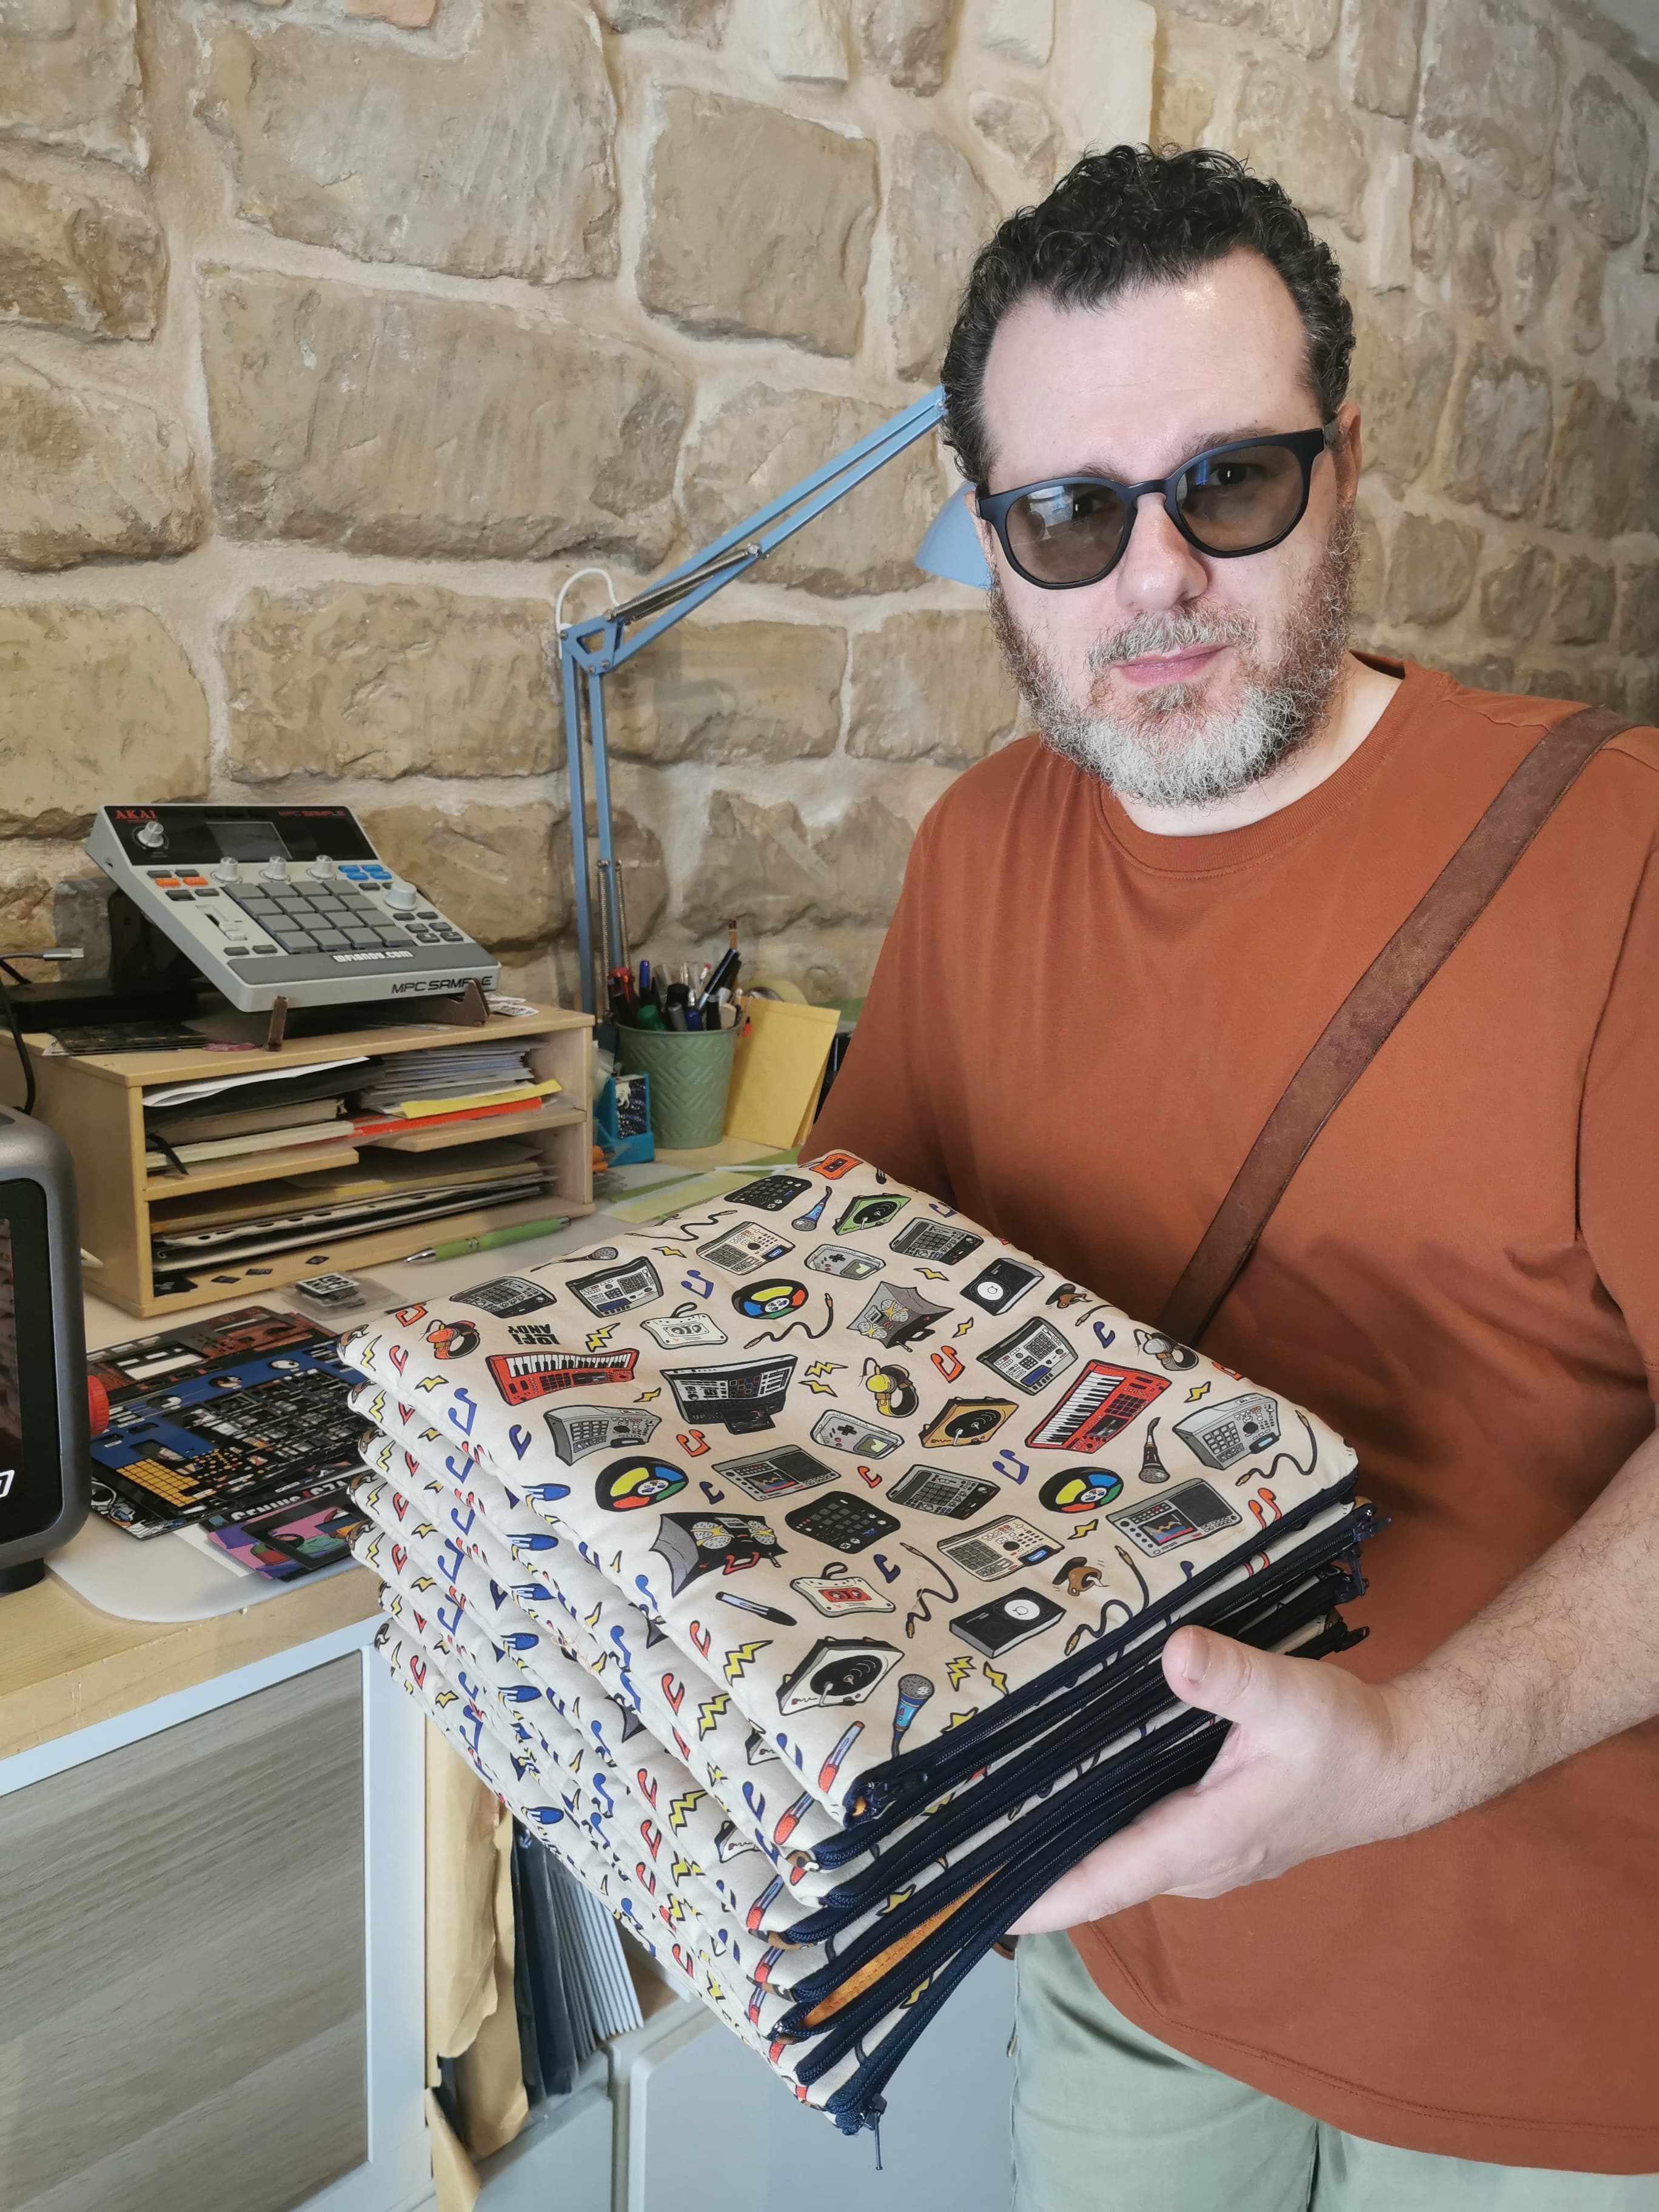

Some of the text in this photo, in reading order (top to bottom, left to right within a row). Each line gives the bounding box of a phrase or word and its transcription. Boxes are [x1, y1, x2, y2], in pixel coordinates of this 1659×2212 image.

[115, 809, 156, 820] AKAI
[392, 982, 427, 994] MPC
[508, 1324, 551, 1334] ANDY
